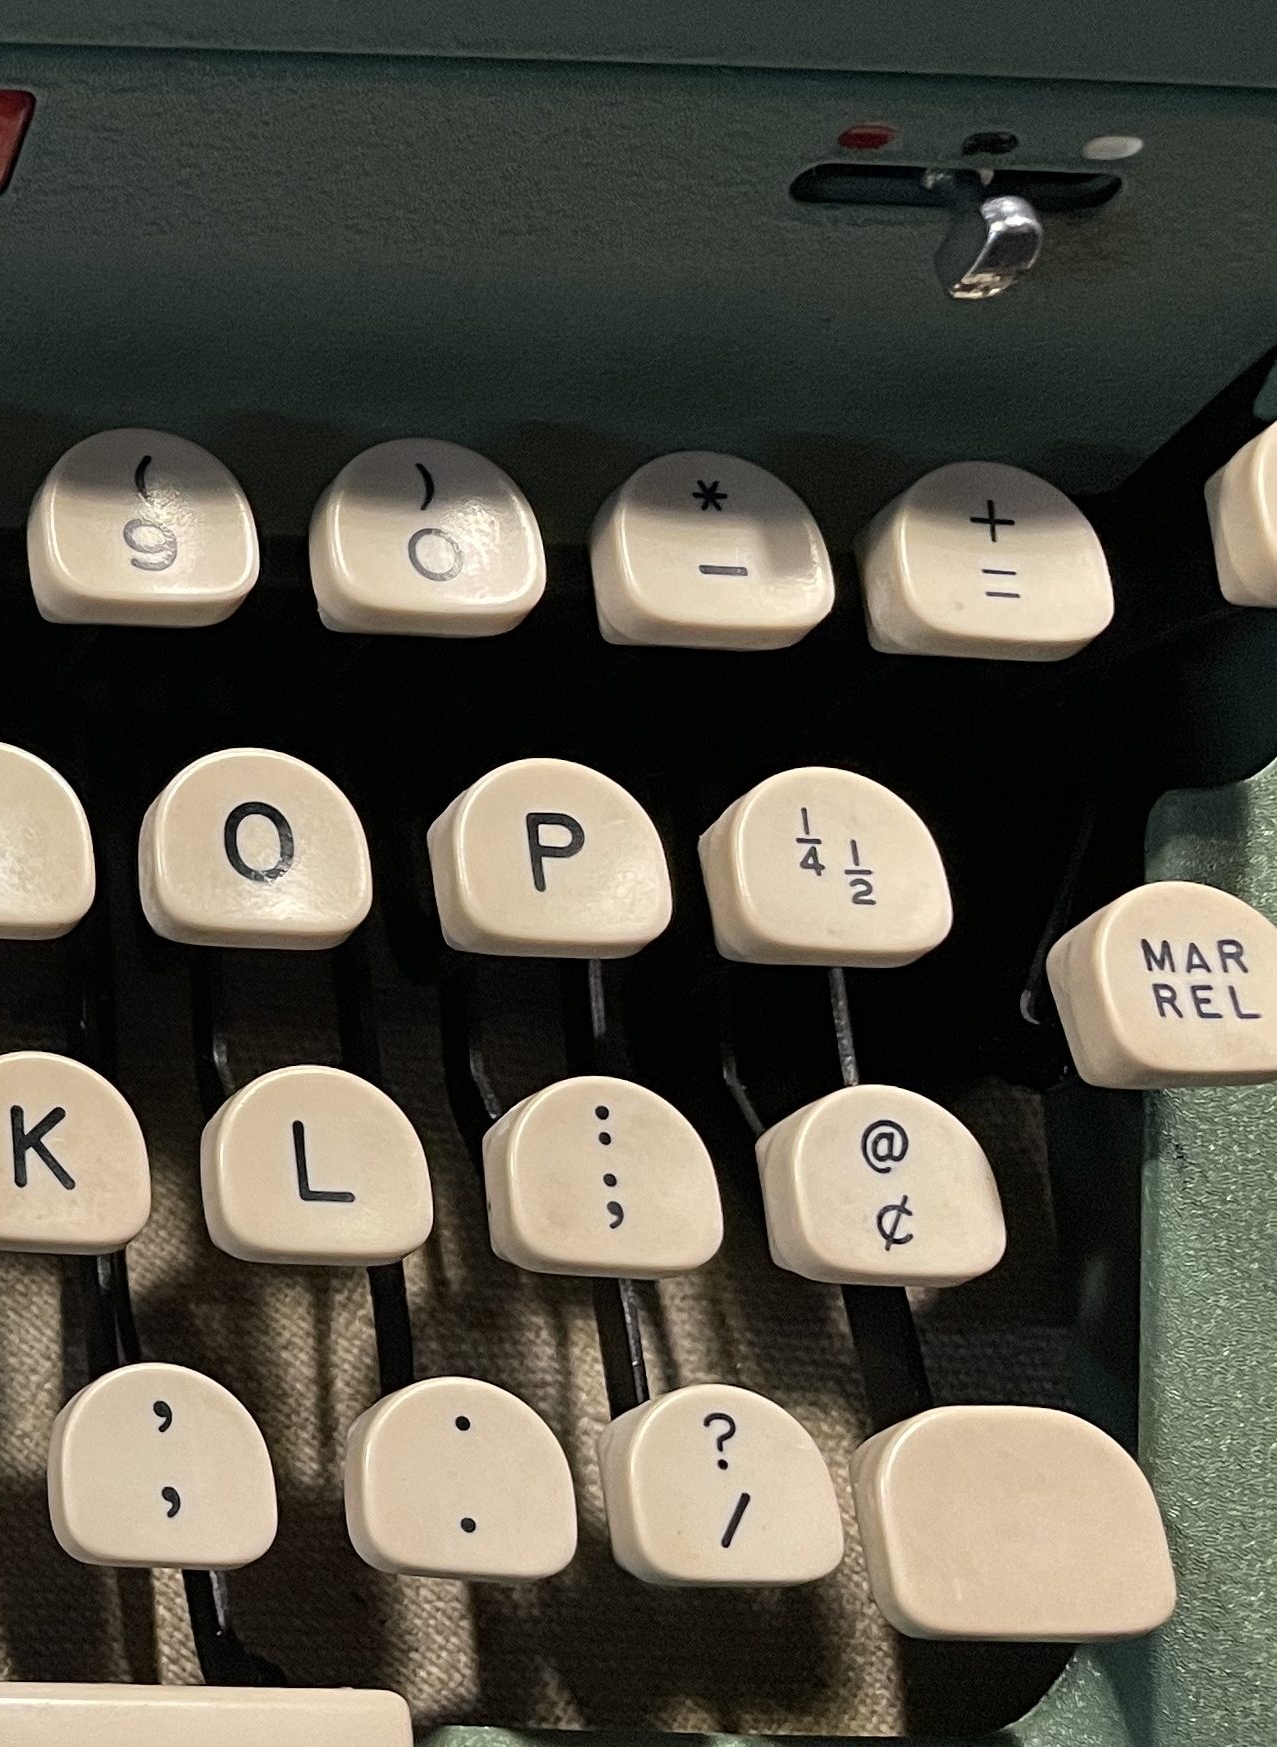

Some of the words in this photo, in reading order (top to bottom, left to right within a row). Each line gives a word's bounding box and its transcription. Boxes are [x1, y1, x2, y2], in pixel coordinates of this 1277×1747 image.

[415, 463, 435, 511] )
[122, 518, 177, 571] 9
[970, 499, 1015, 543] +
[982, 569, 1020, 598] =
[224, 801, 294, 884] O
[526, 812, 585, 892] P
[1141, 939, 1248, 973] MAR
[1152, 983, 1261, 1019] REL
[10, 1105, 76, 1190] K
[595, 1106, 611, 1145] :
[861, 1120, 909, 1174] @
[292, 1120, 355, 1203] L
[603, 1173, 624, 1229] ;
[877, 1195, 913, 1251] ¢
[703, 1413, 736, 1470] ?
[161, 1486, 181, 1518] ,
[461, 1517, 476, 1533] .
[721, 1492, 751, 1548] /
